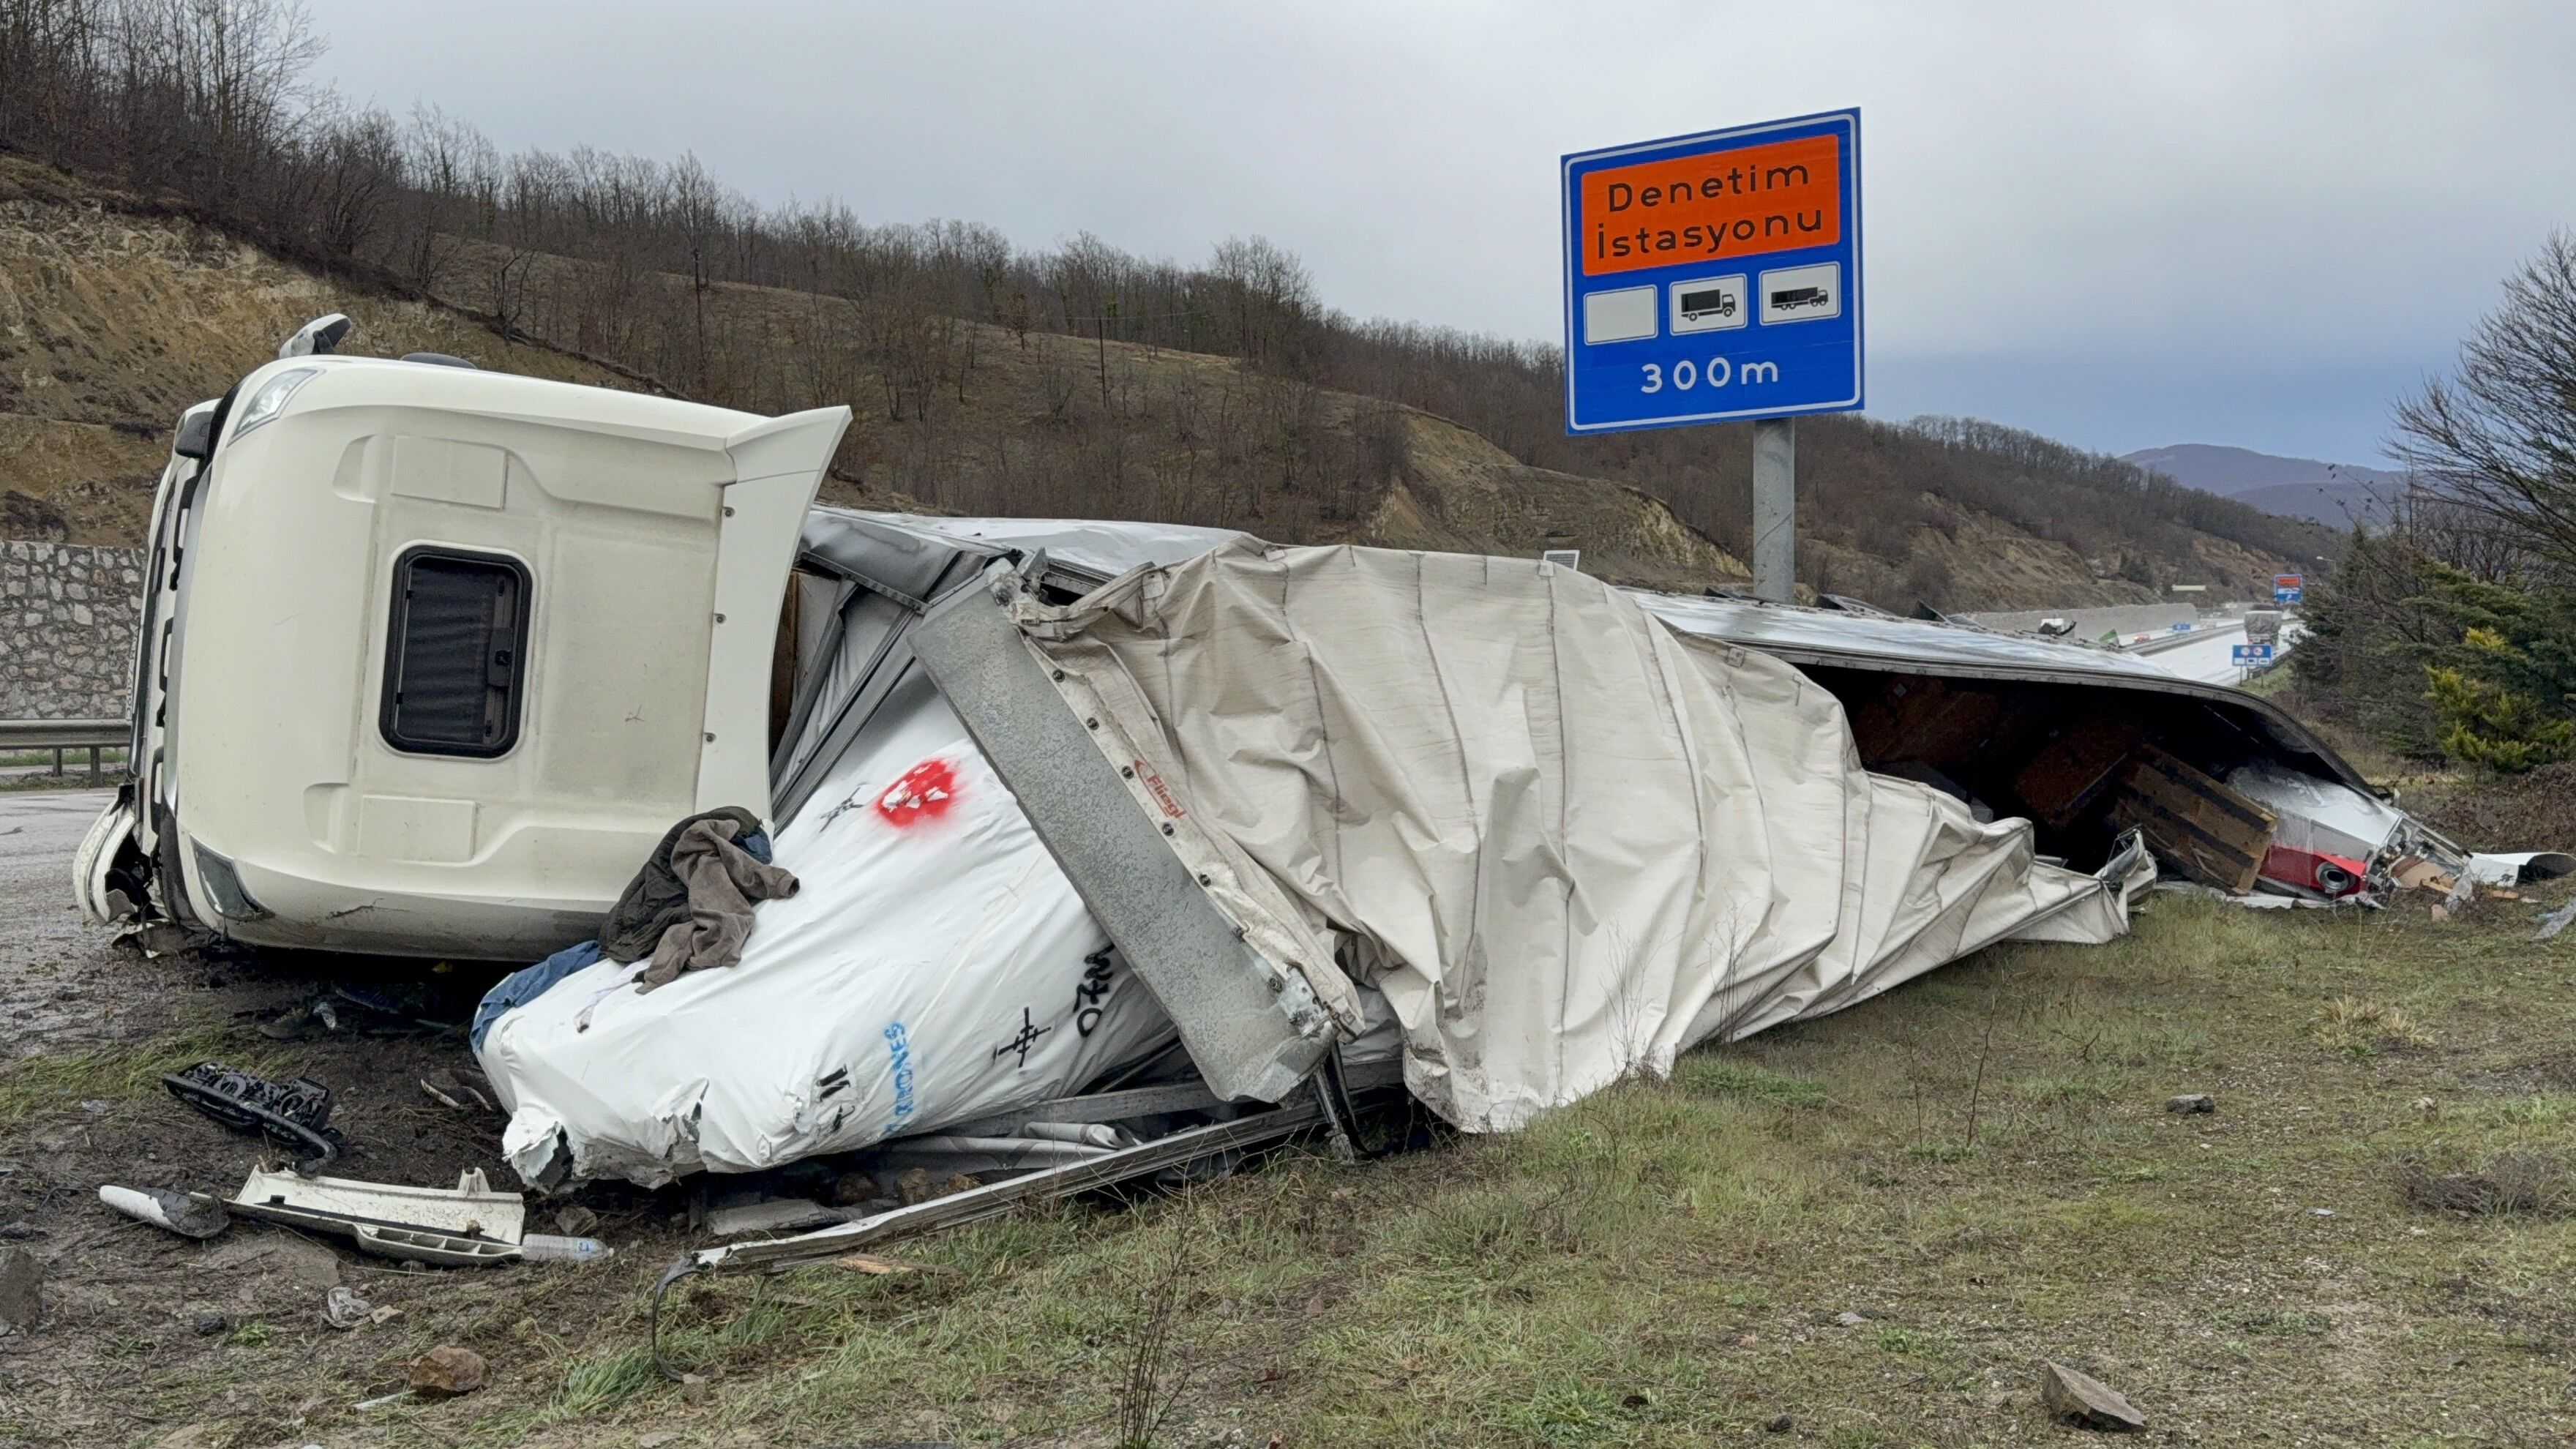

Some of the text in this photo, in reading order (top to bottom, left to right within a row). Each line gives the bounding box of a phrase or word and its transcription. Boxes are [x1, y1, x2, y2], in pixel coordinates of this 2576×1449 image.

[1607, 164, 1810, 213] Denetim
[1598, 209, 1822, 260] İstasyonu
[1146, 774, 1187, 818] Fliegl
